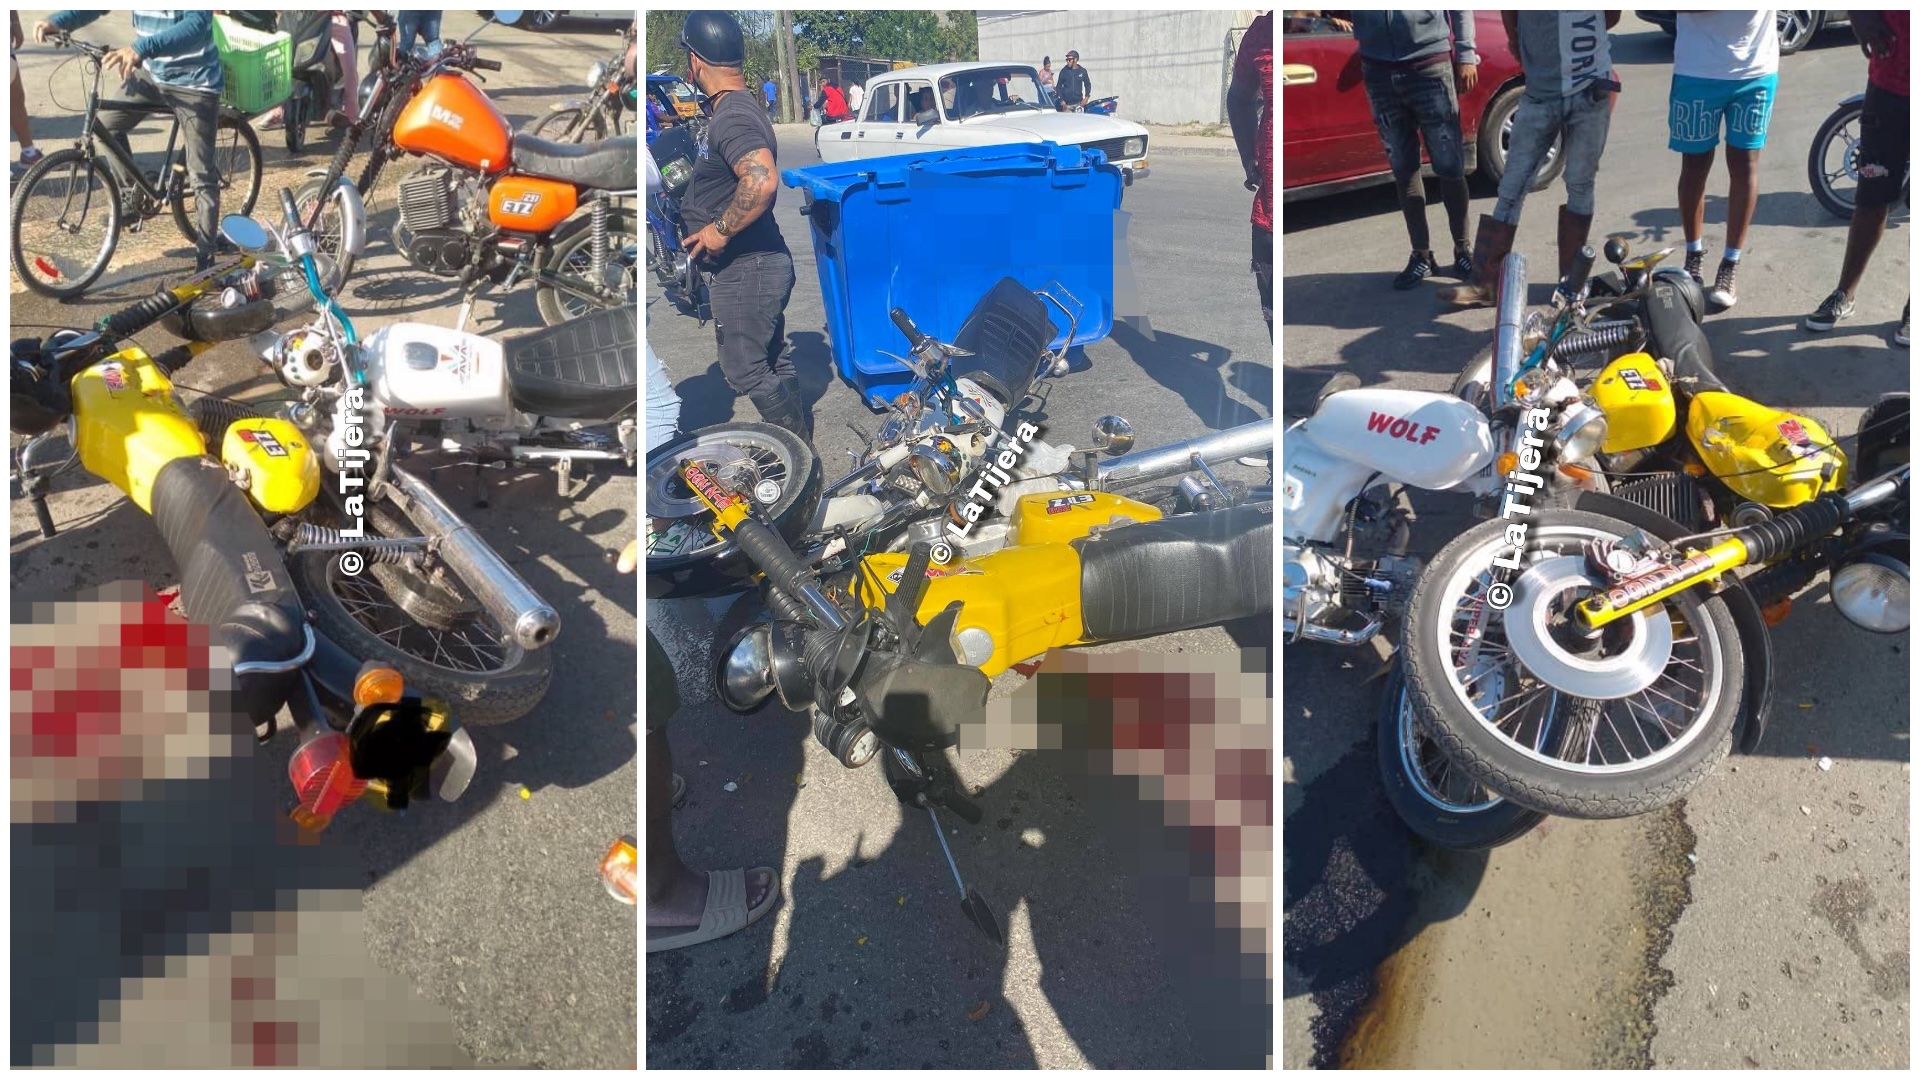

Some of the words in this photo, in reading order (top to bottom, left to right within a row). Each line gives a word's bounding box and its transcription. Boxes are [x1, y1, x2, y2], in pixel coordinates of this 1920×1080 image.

[1571, 15, 1601, 88] YORK
[502, 199, 533, 215] ETZ
[384, 406, 446, 416] WOLF
[1366, 411, 1441, 445] WOLF
